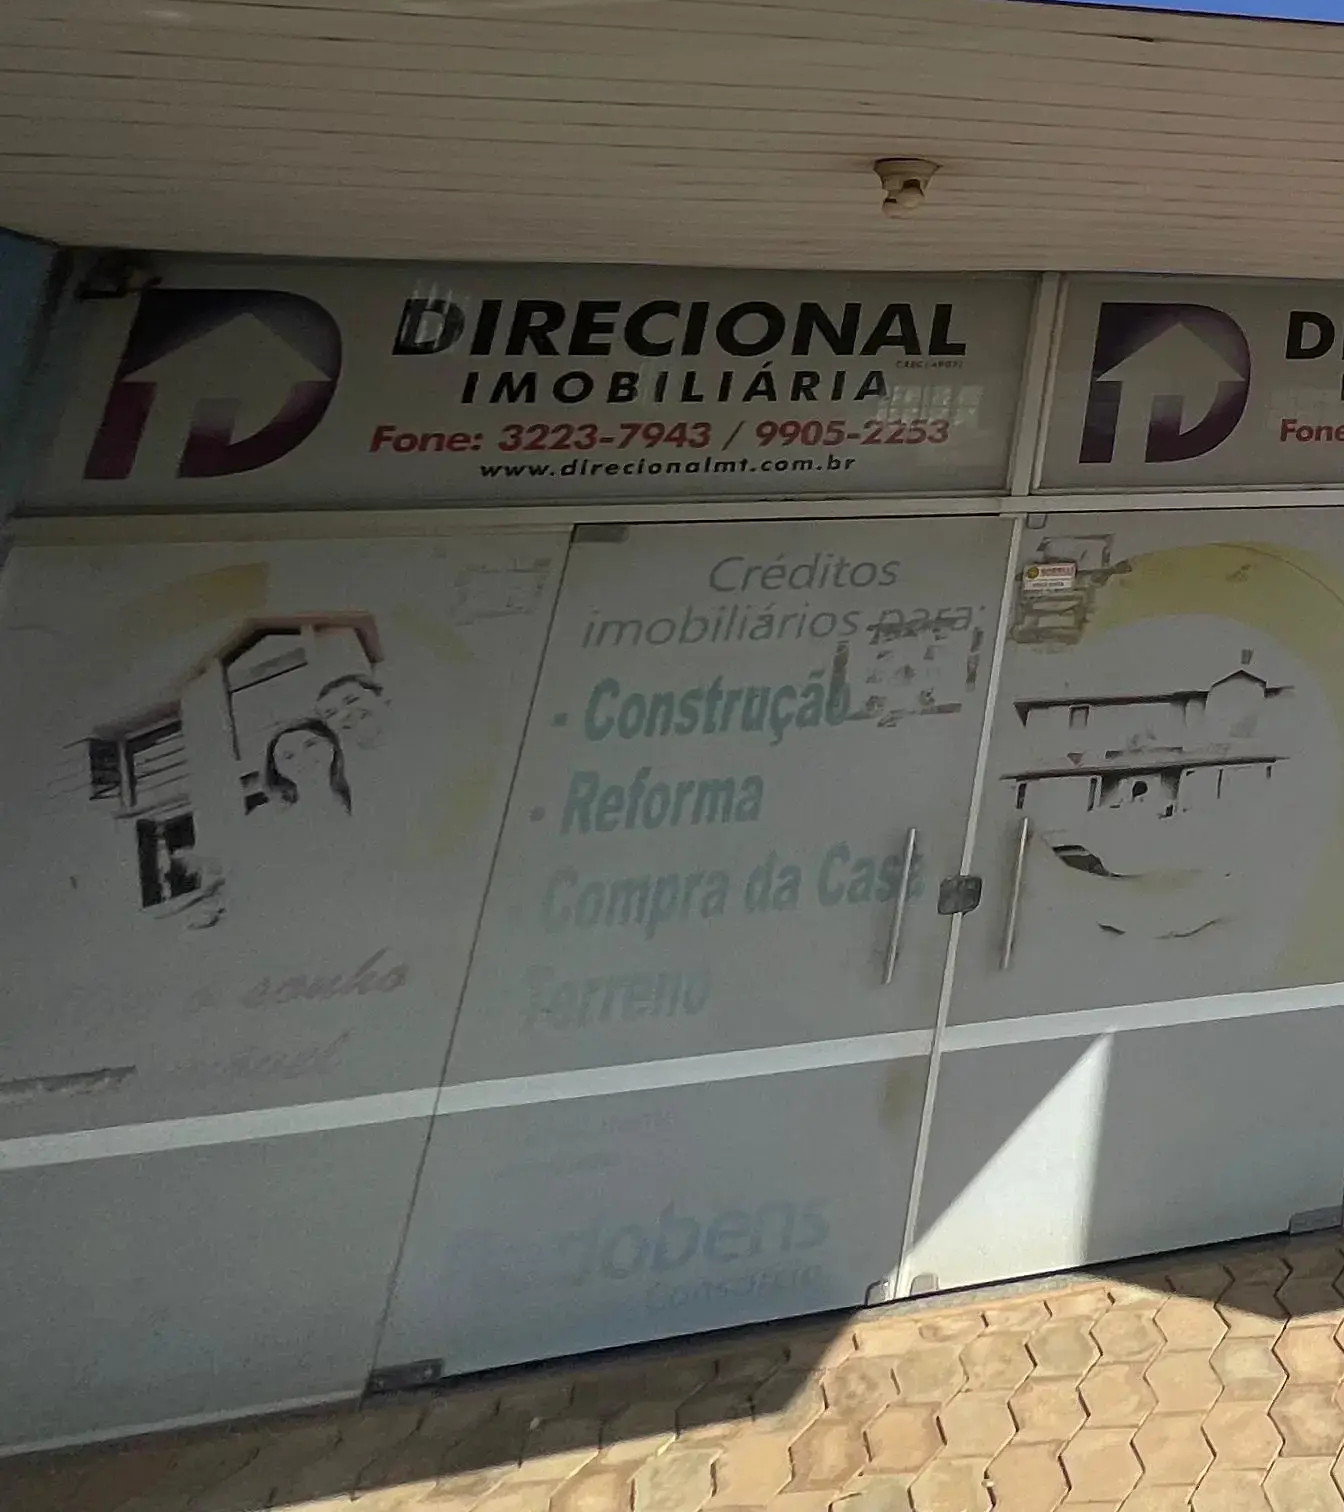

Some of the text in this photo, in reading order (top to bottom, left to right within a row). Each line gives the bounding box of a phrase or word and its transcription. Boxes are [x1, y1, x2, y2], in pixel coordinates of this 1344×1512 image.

[391, 299, 968, 357] DIRECIONAL
[460, 361, 890, 404] IMOBILIÁRIA
[368, 419, 951, 454] Fone: 3223-7943 / 9905-2253
[479, 454, 857, 479] www.direcionalmt.com.br
[707, 552, 902, 594] Créditos
[580, 602, 859, 649] imobiliários
[584, 668, 853, 747] Construção
[560, 765, 764, 836] Reforma
[542, 863, 731, 941] Compra
[744, 856, 803, 915] da
